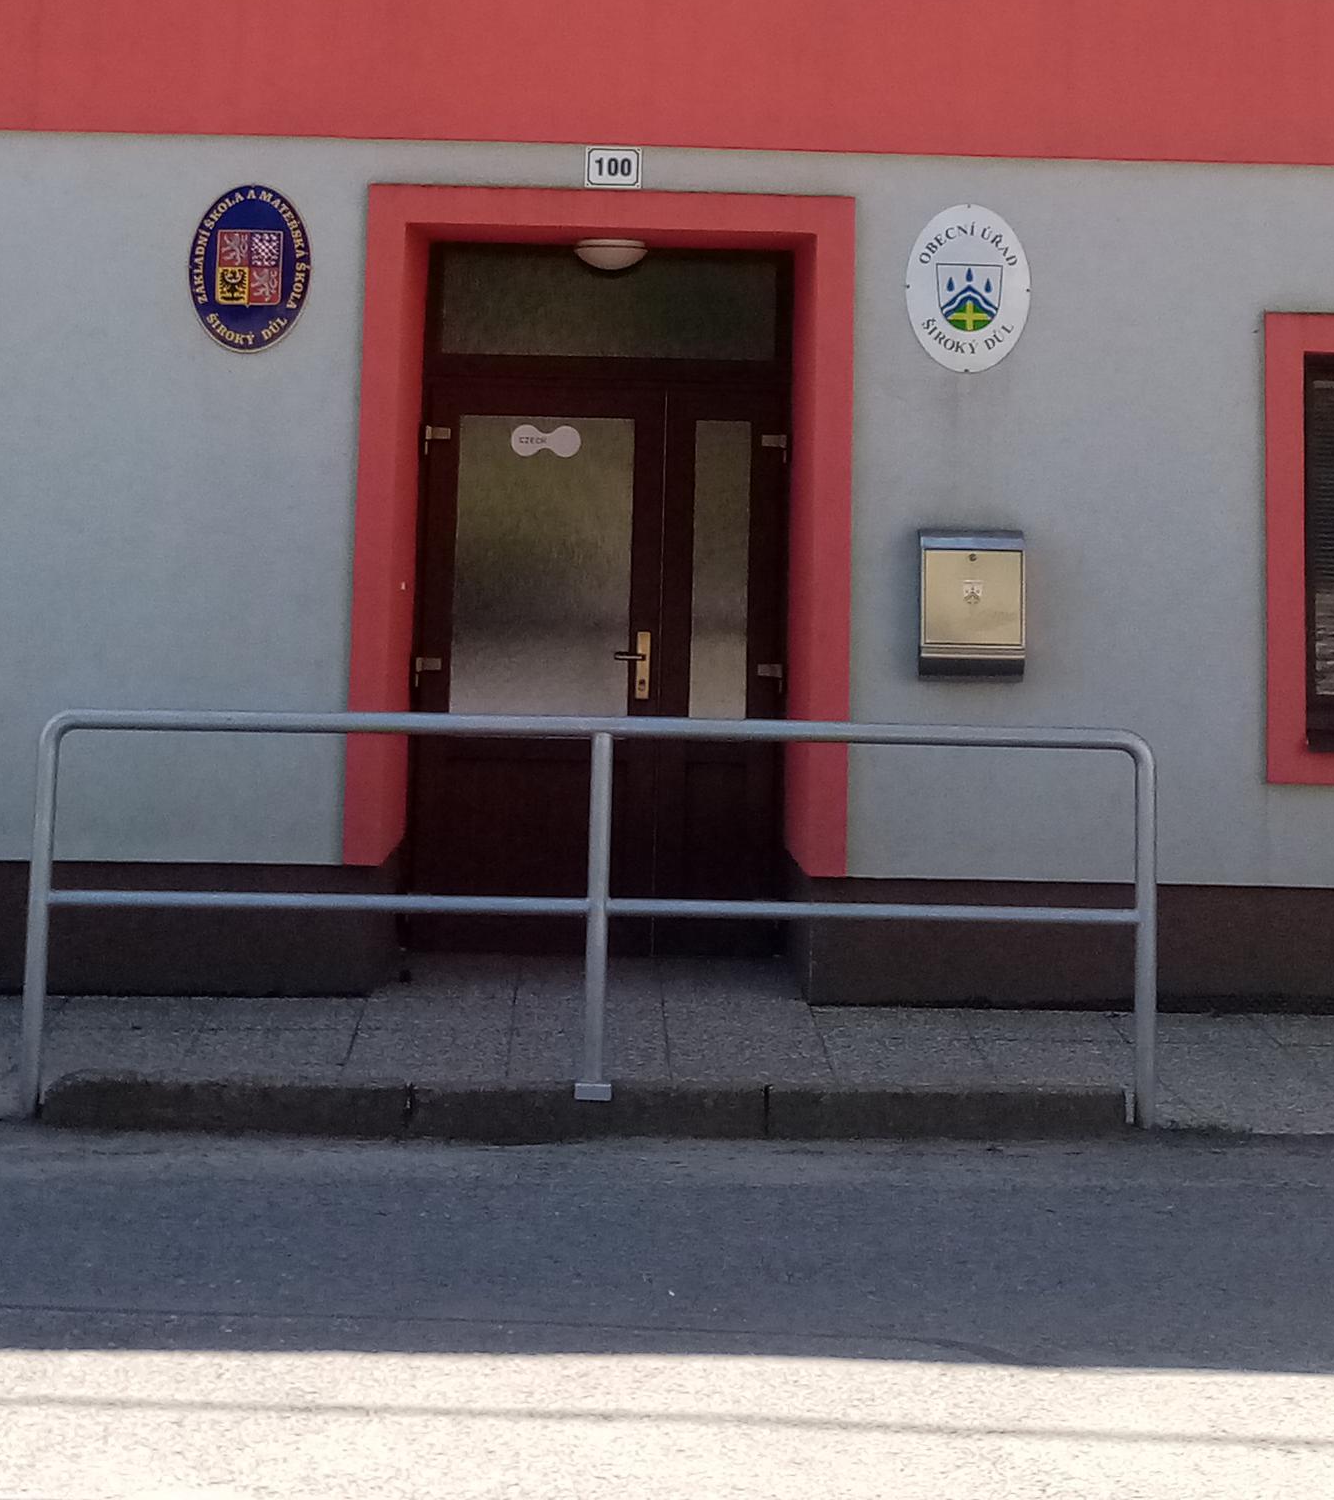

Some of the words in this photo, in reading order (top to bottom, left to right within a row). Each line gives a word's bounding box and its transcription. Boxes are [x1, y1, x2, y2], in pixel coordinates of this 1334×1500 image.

[595, 157, 632, 177] 100
[191, 228, 211, 305] ZÁKLADNÍ
[246, 189, 257, 200] A
[286, 262, 311, 311] ŠKOLA
[918, 221, 976, 264] OBECNÍ
[980, 226, 1018, 267] ÚŘAD
[206, 312, 255, 345] ŠIROKÝ
[261, 317, 288, 341] DŮL
[984, 323, 1015, 351] DŮL
